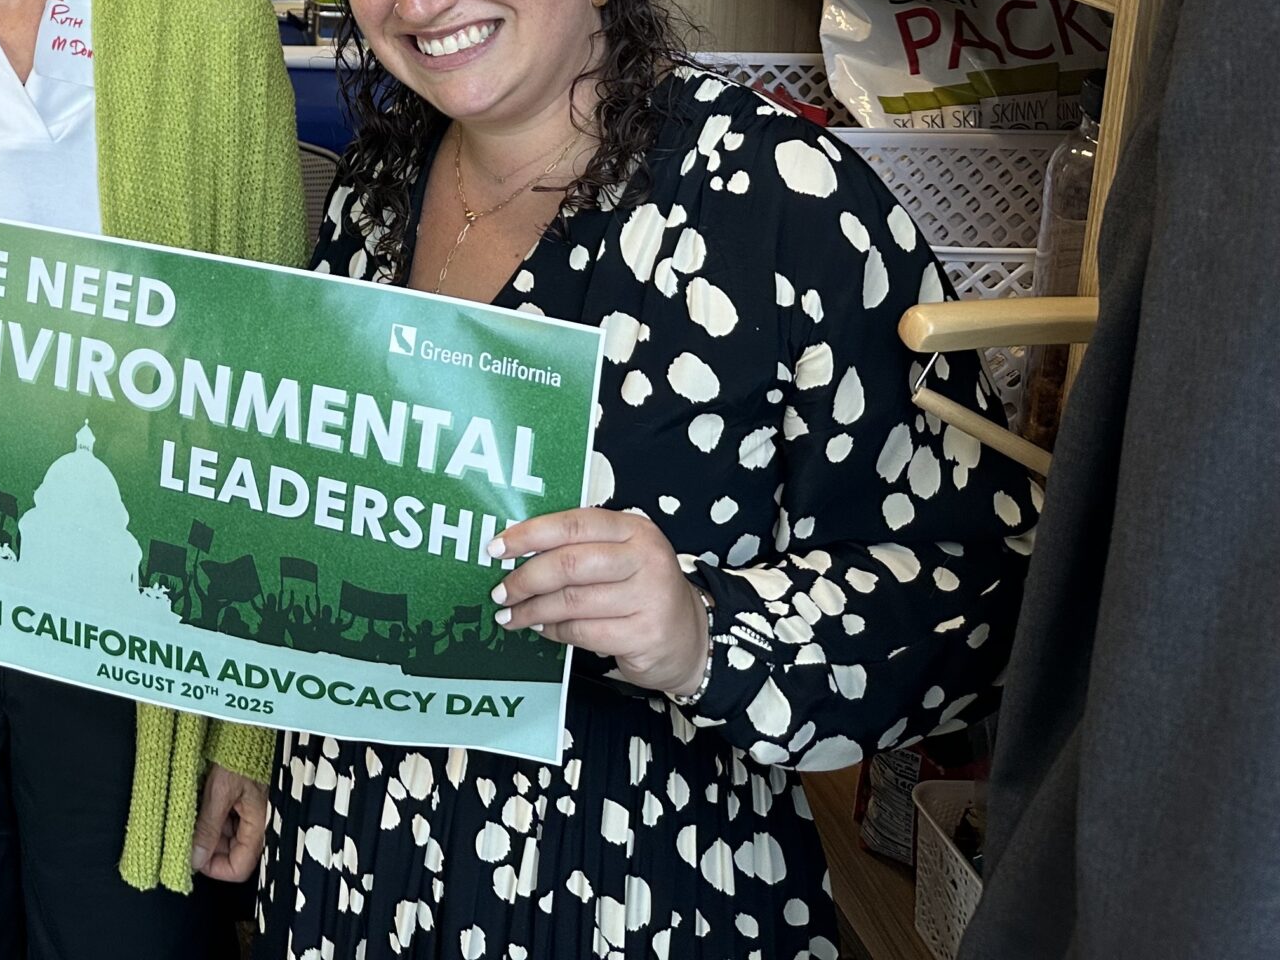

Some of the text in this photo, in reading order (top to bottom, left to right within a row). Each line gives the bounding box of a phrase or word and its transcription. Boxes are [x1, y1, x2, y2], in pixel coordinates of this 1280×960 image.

[991, 98, 1048, 124] SKINNY
[26, 255, 176, 327] NEED
[420, 340, 562, 388] Green California
[11, 605, 211, 678] CALIFORNIA
[217, 658, 436, 714] ADVOCACY
[445, 693, 525, 718] DAY
[96, 663, 275, 715] AUGUST 20TH 2025
